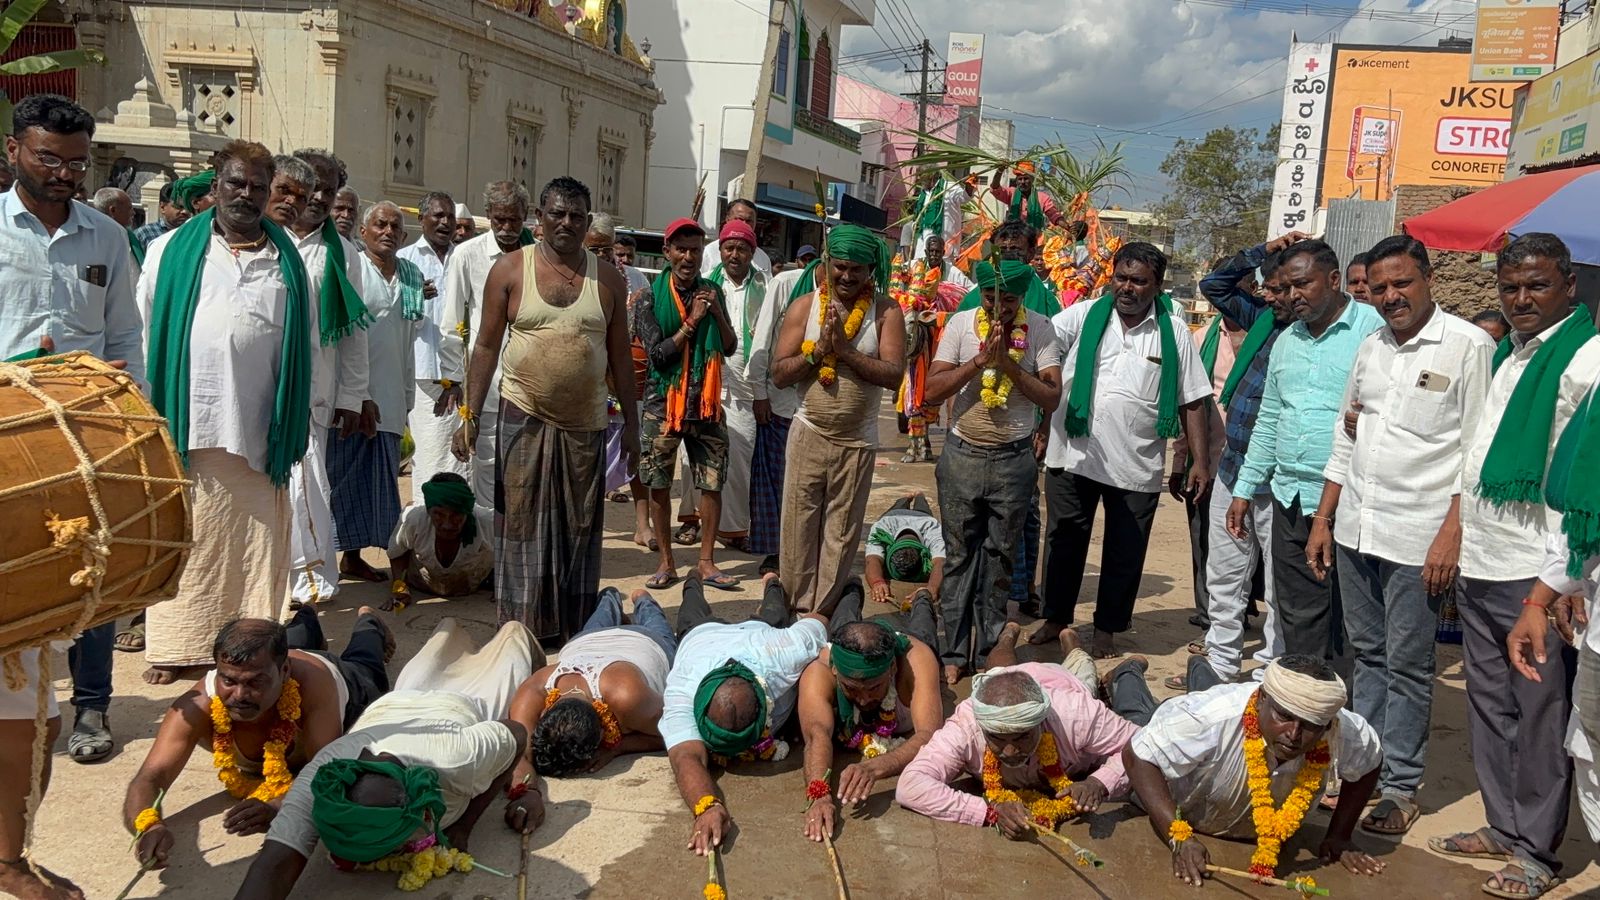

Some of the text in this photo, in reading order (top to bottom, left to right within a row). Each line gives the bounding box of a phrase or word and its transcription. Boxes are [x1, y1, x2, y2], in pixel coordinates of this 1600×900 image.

[1479, 47, 1502, 55] Union
[948, 72, 977, 82] GOLD
[948, 87, 976, 96] LOAN
